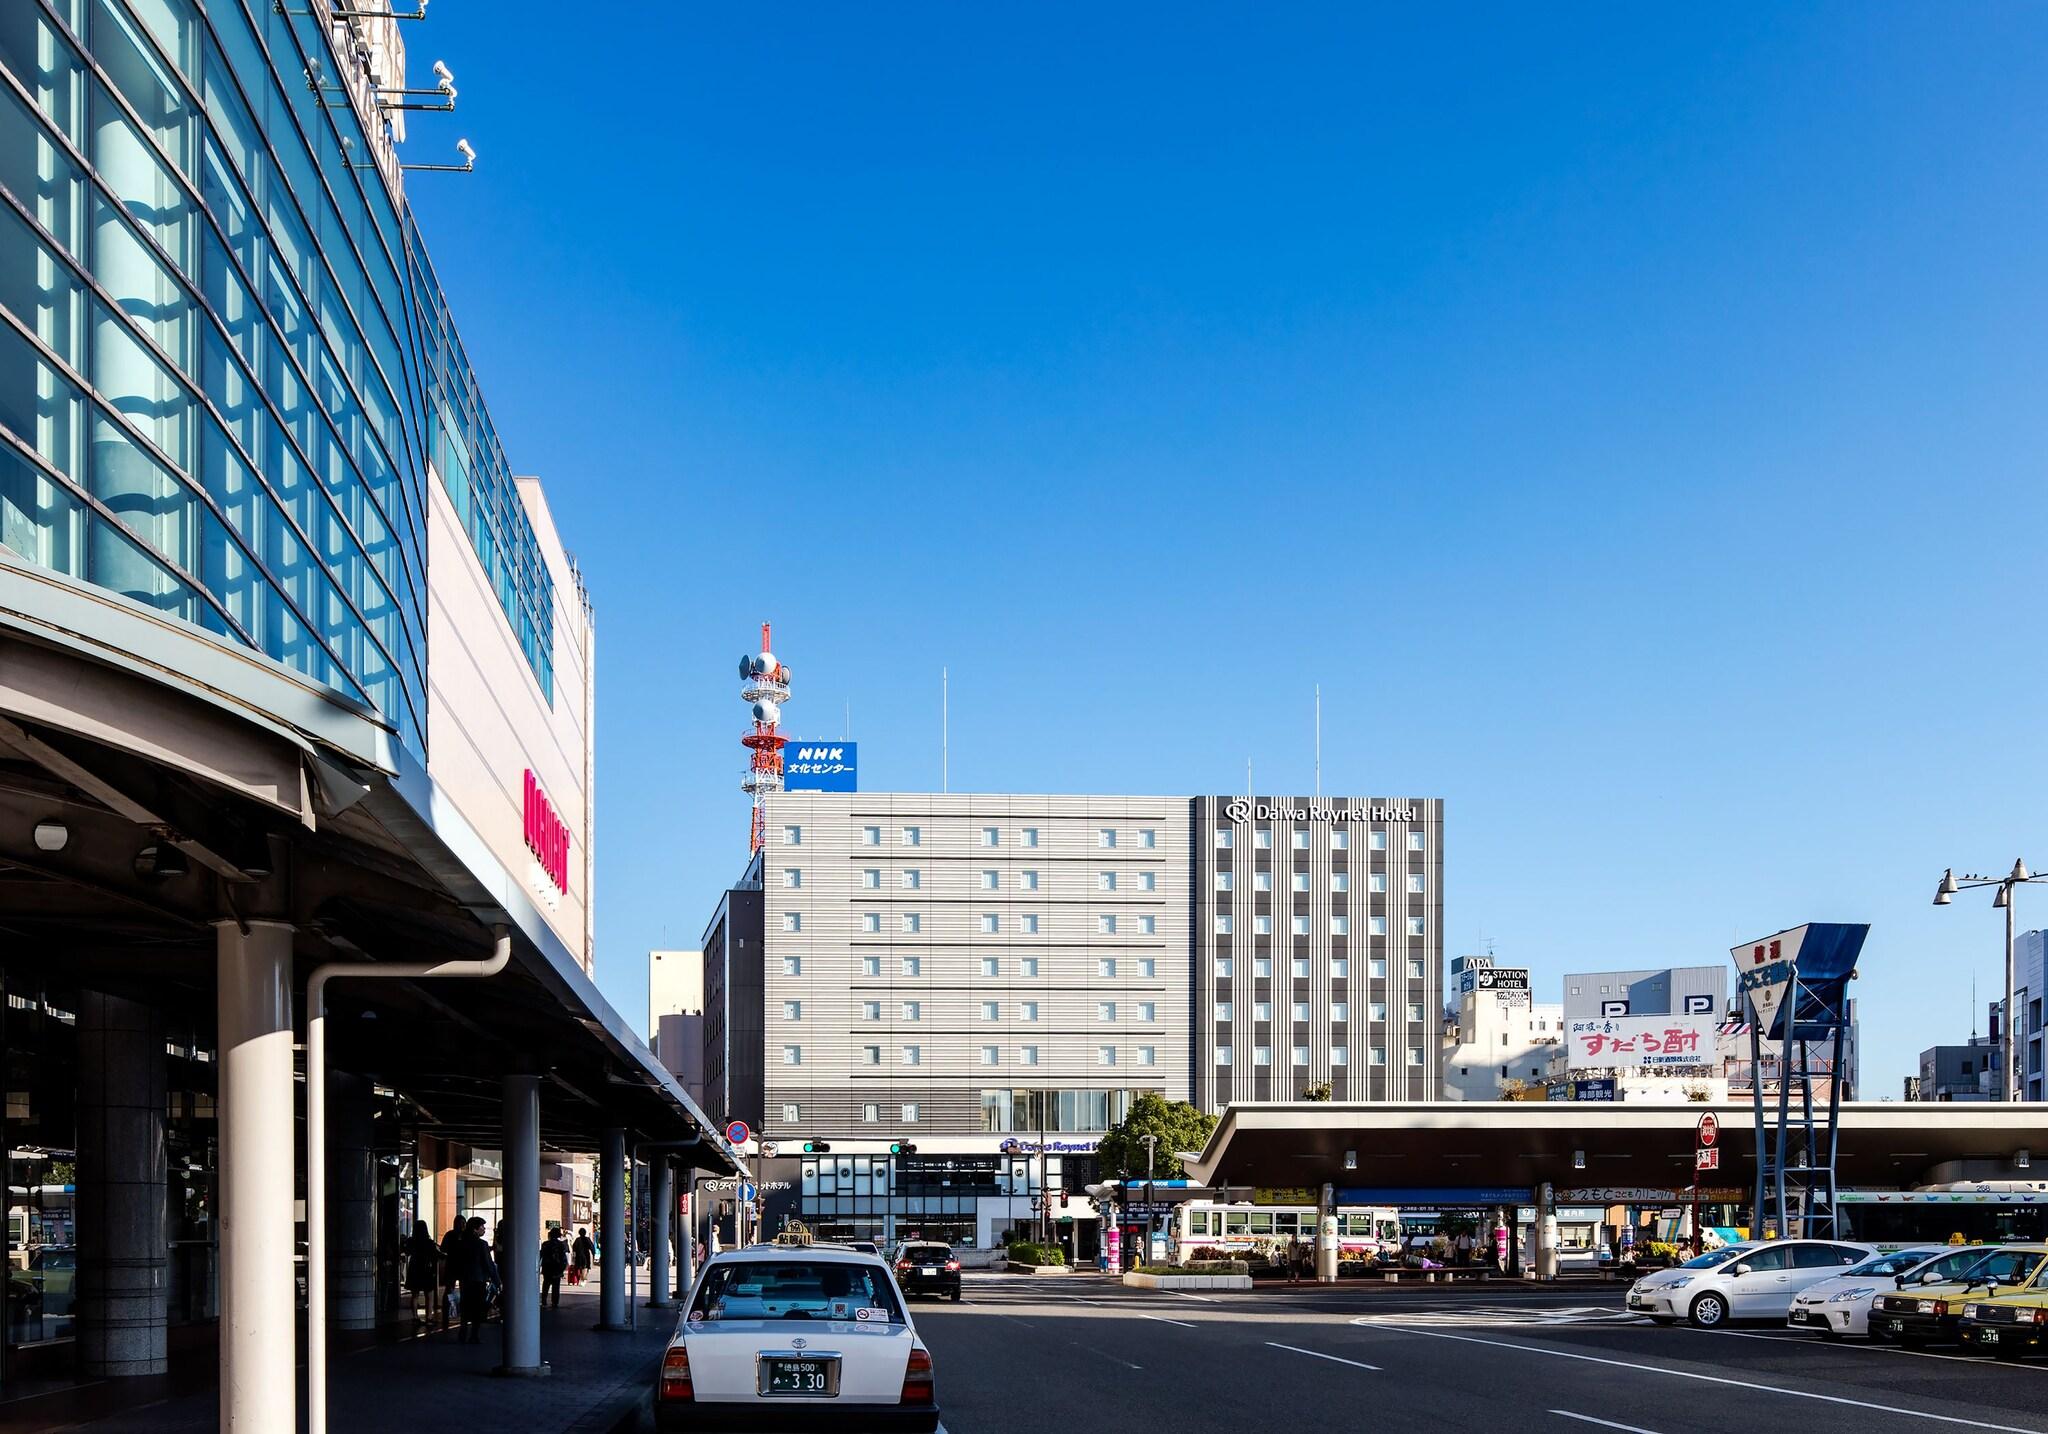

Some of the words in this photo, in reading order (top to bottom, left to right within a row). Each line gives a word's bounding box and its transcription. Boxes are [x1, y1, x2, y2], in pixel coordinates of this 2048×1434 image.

[798, 747, 844, 760] NHK
[787, 763, 855, 774] 文化センター
[1256, 804, 1306, 821] Daiwa
[1309, 805, 1369, 826] Roynet
[1371, 807, 1417, 822] Hotel
[1466, 958, 1492, 969] APA
[1493, 970, 1528, 979] STATION
[1497, 980, 1524, 988] HOTEL
[1604, 1002, 1627, 1018] P
[1689, 997, 1710, 1015] P
[1580, 1028, 1700, 1056] すだち酎
[1053, 1141, 1091, 1153] Roynet
[1545, 1186, 1553, 1200] 6
